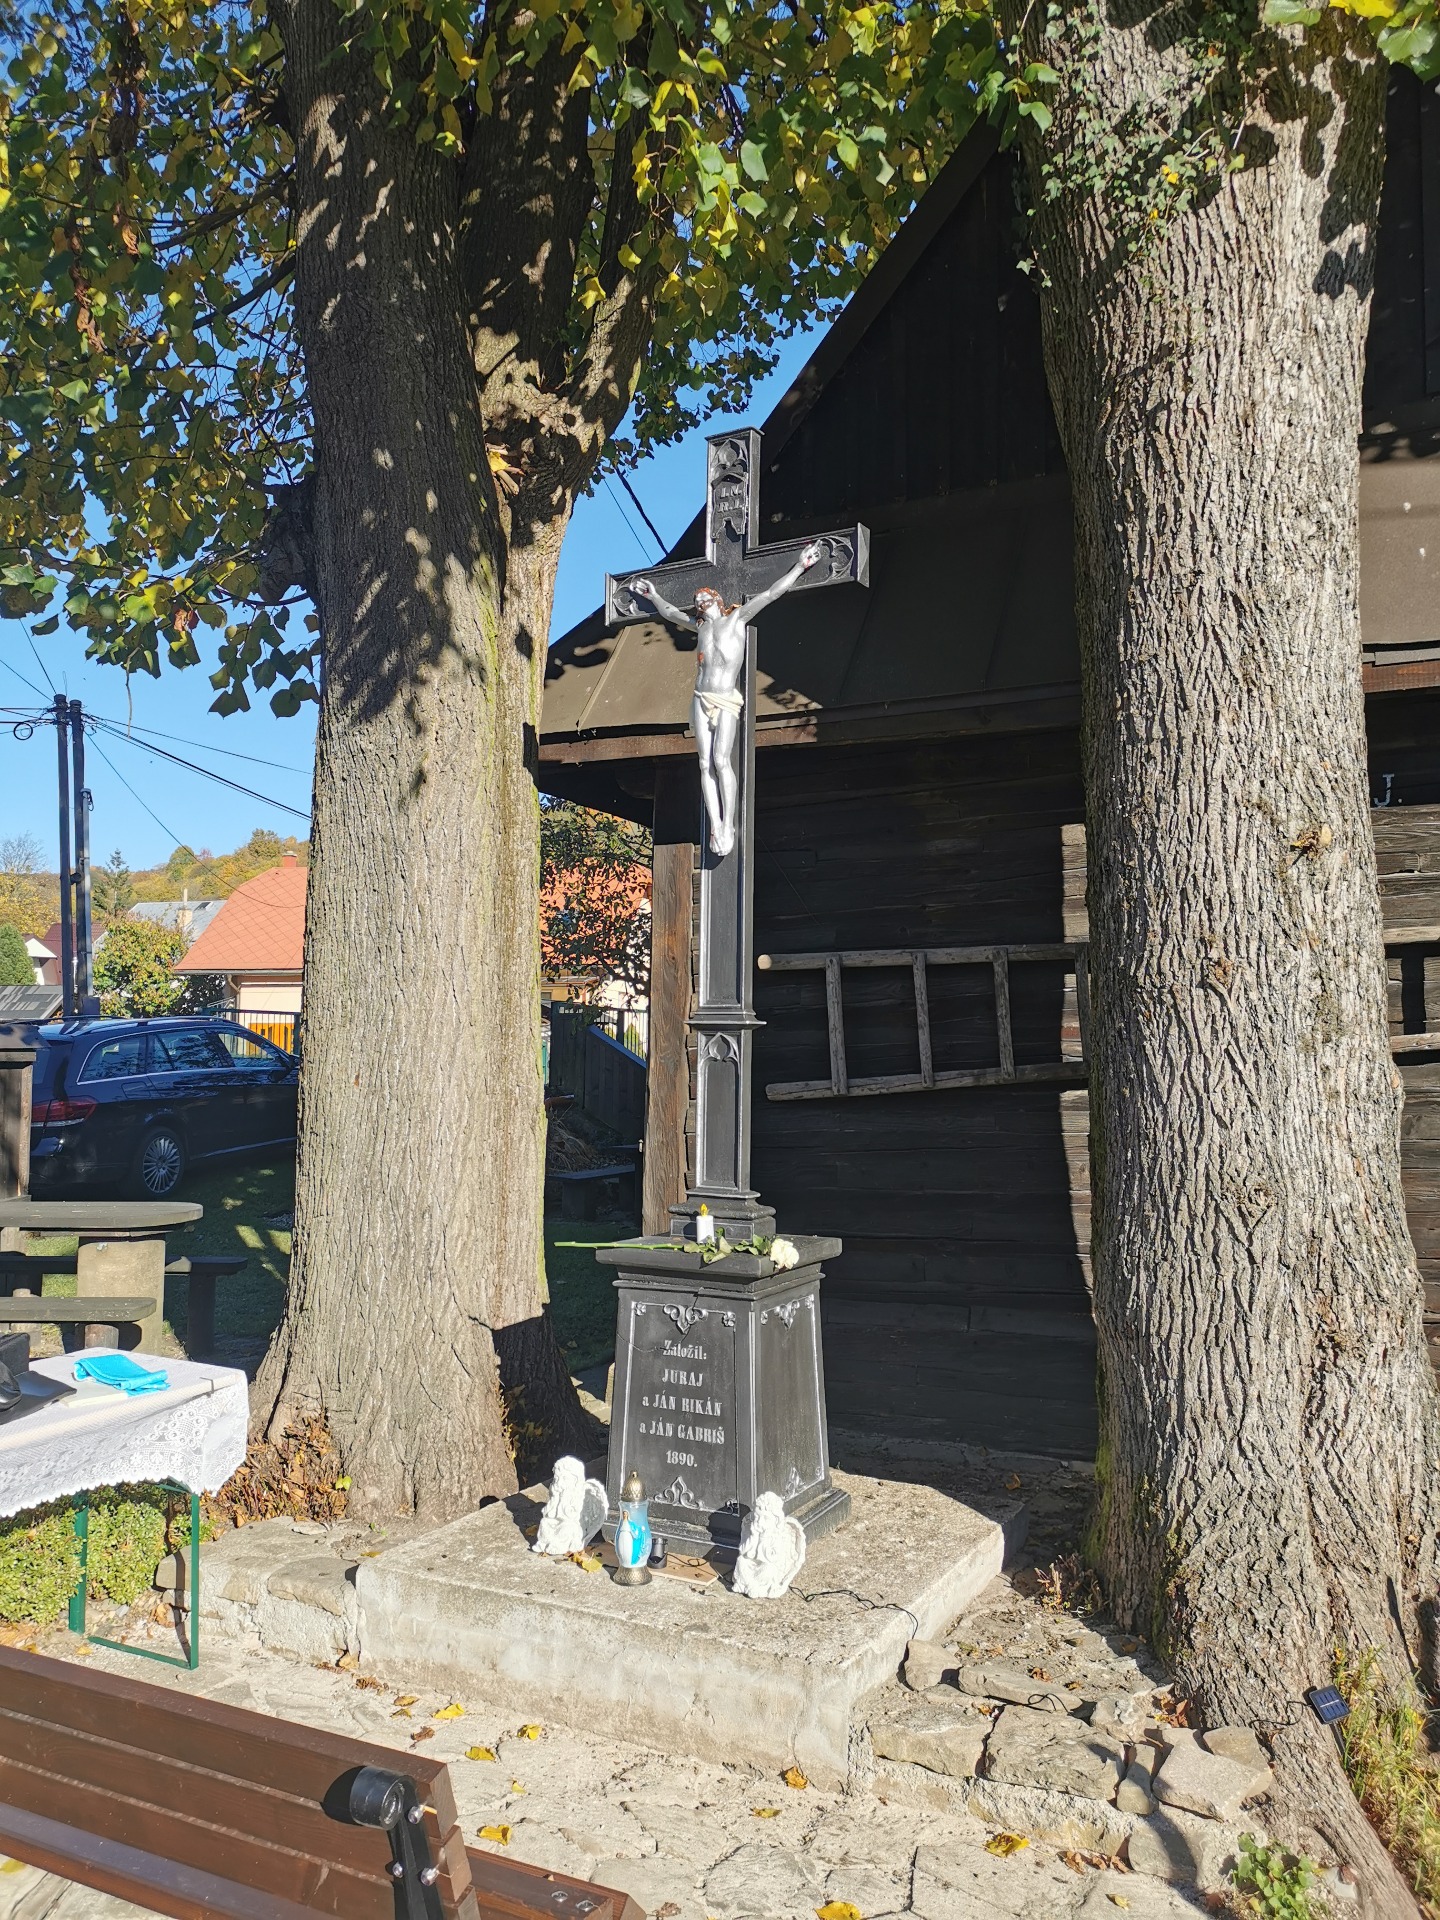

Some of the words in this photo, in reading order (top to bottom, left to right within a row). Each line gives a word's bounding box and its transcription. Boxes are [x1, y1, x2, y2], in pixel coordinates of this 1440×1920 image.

[661, 1368, 703, 1387] JURAJ
[642, 1395, 650, 1407] a
[652, 1390, 676, 1410] JÁN
[639, 1422, 647, 1434] a
[649, 1416, 674, 1437] JÁN
[677, 1424, 725, 1444] GABRIŠ
[665, 1449, 698, 1467] 1890.
